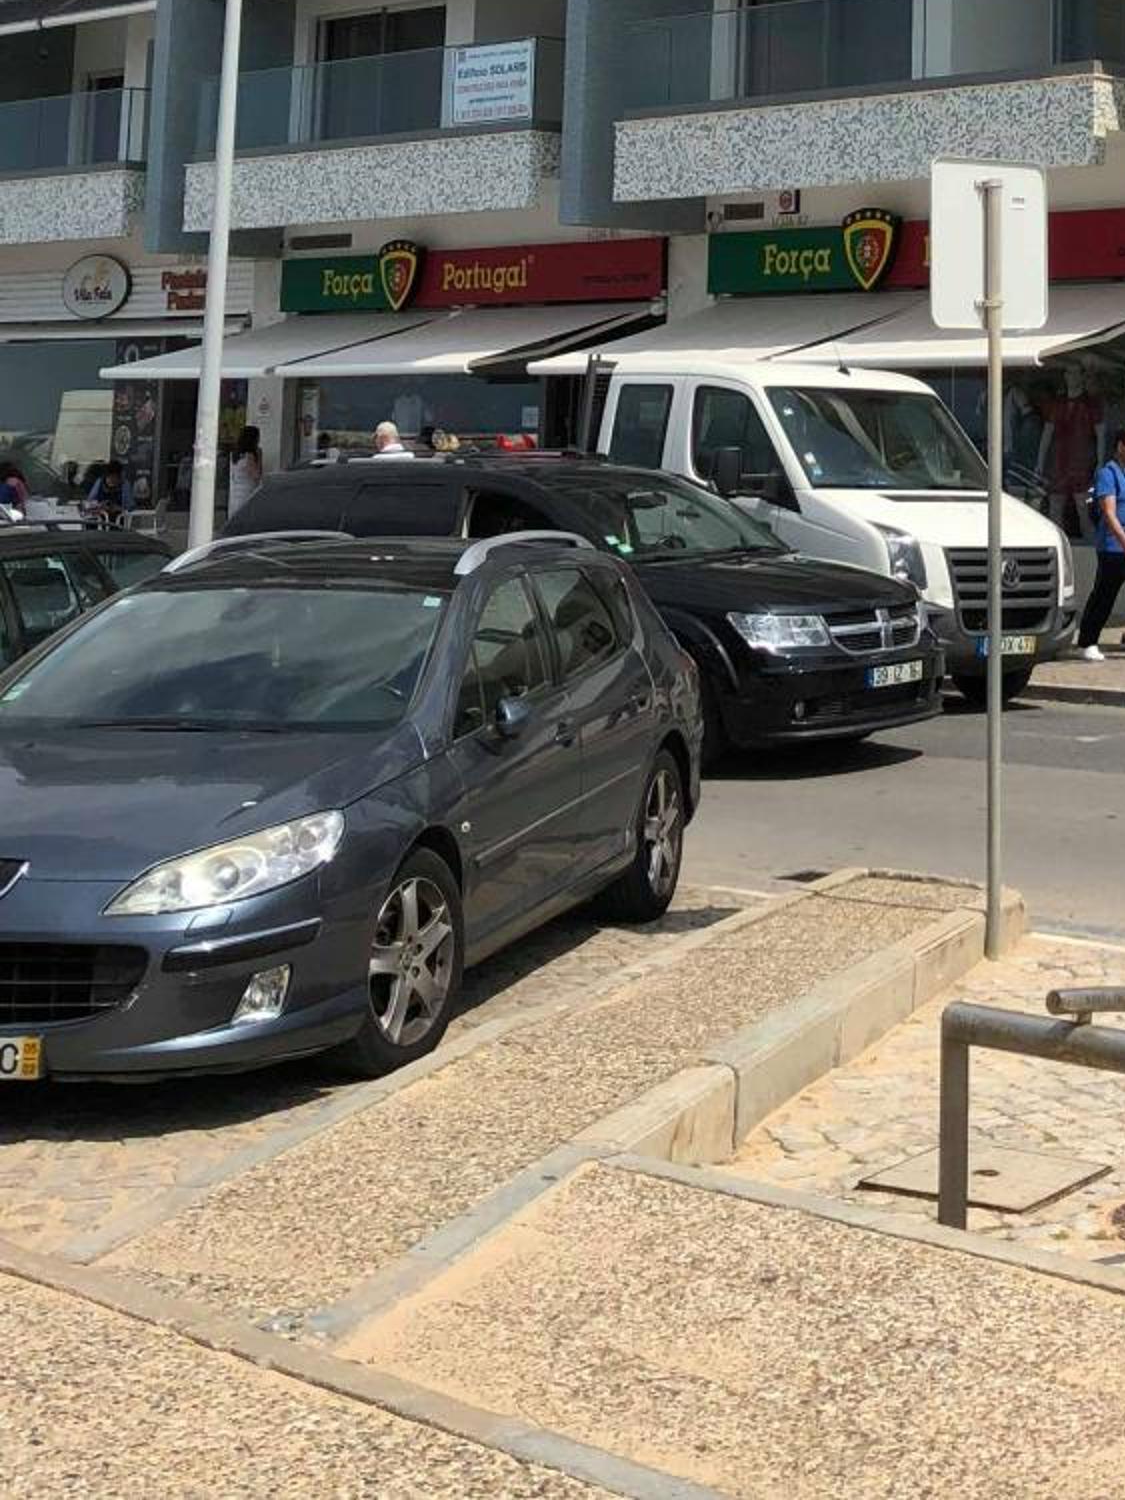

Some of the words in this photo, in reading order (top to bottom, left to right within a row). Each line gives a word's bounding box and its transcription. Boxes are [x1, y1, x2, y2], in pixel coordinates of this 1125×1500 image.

[489, 61, 528, 75] SOLARIS
[321, 268, 374, 301] Força
[442, 258, 529, 293] Portugal
[763, 243, 832, 281] Força
